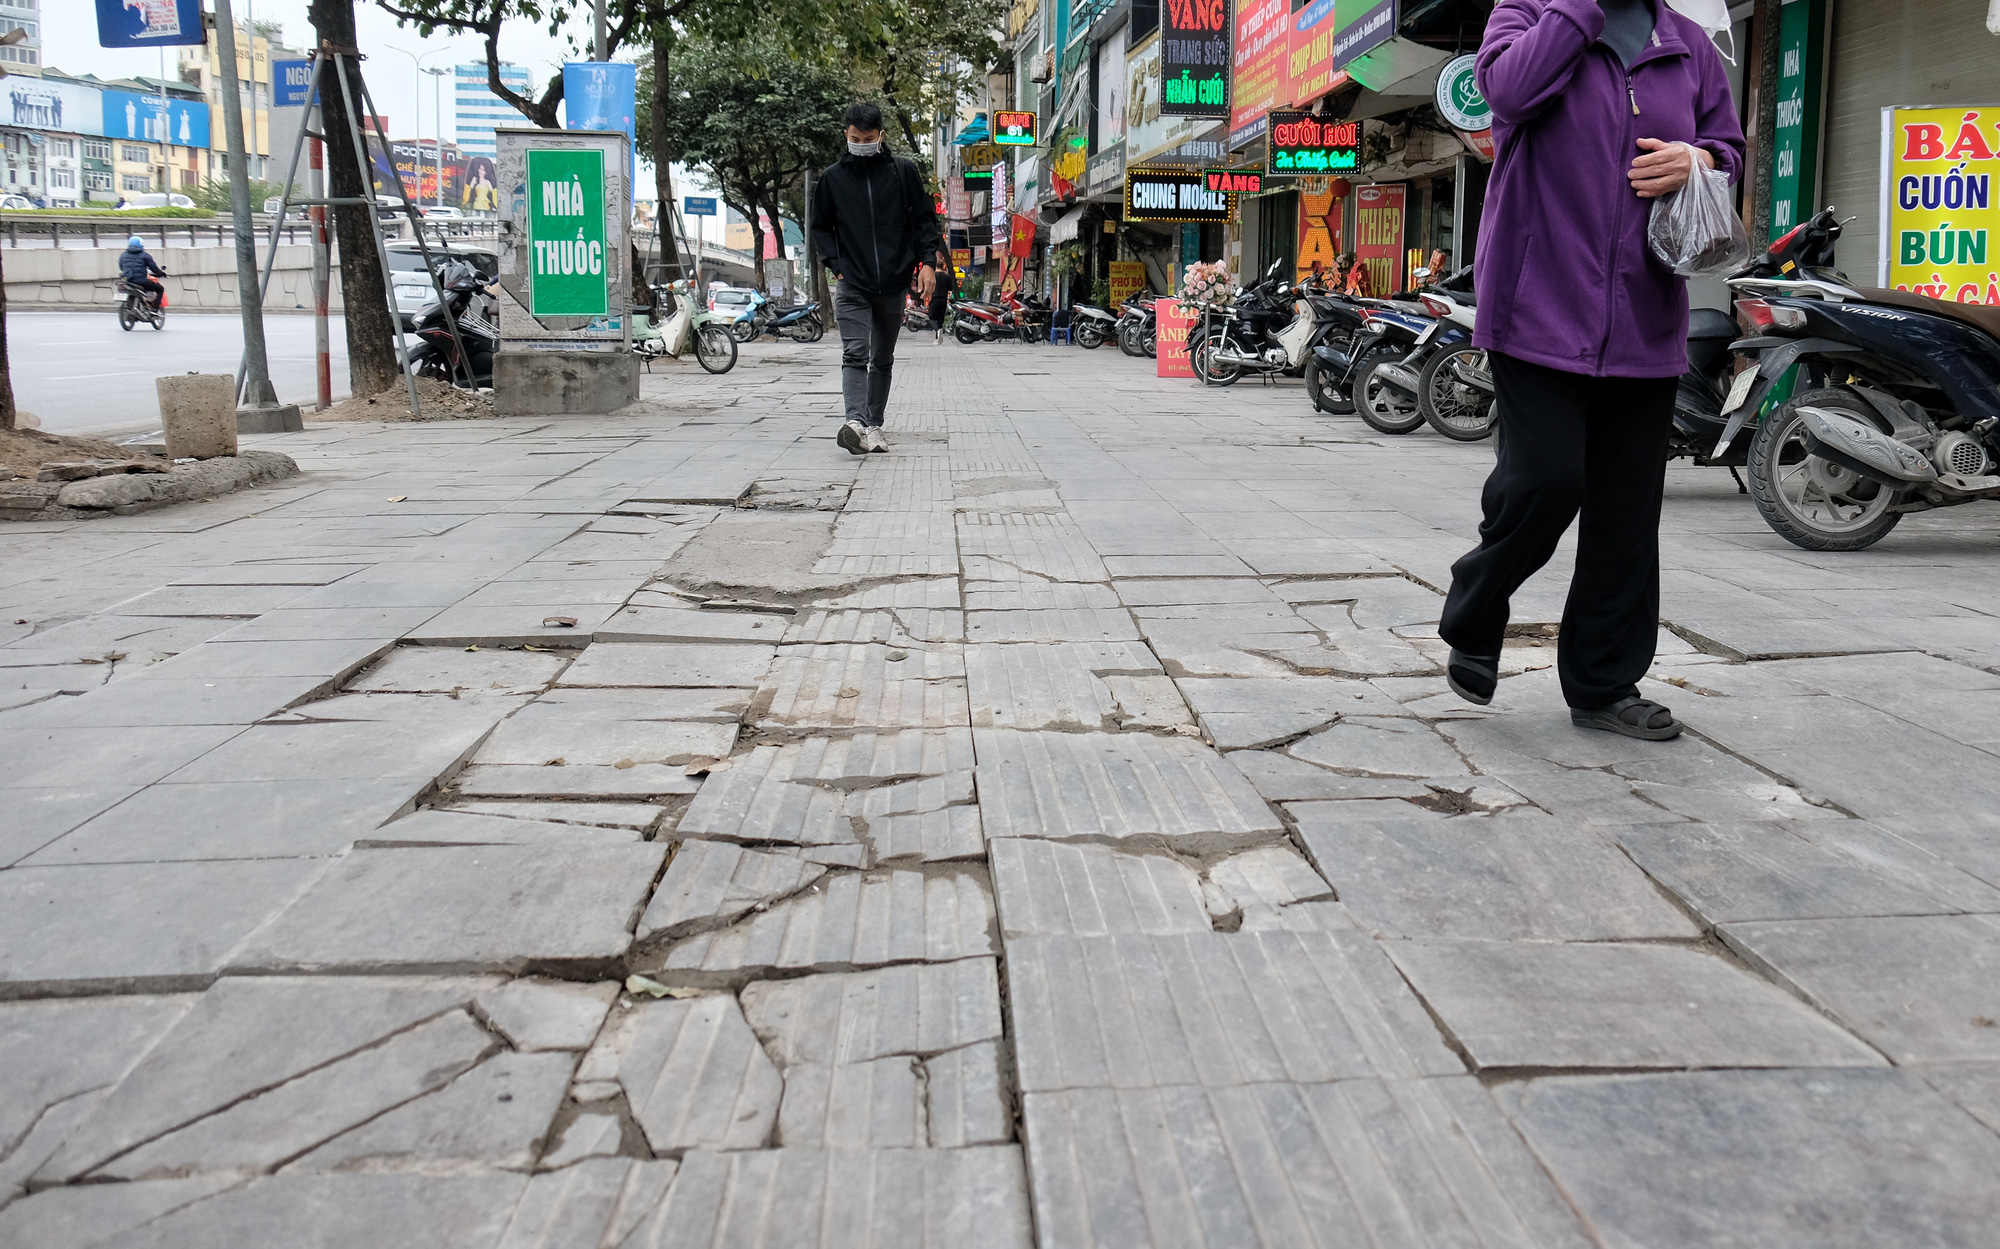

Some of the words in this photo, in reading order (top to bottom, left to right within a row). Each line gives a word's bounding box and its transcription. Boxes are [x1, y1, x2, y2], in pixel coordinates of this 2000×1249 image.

[1280, 13, 1288, 35] HD
[1166, 39, 1202, 65] TRANG
[1204, 35, 1226, 66] SỨC
[1290, 43, 1311, 80] CHỤP
[1311, 27, 1329, 68] ẢNH
[1783, 40, 1800, 78] NHÀ
[1166, 69, 1197, 104] NHẪN
[1198, 72, 1224, 105] CƯỚI
[1298, 78, 1311, 100] LẤY
[1310, 70, 1329, 93] NGAY
[1443, 73, 1452, 92] NONG
[140, 95, 172, 107] COWY
[1776, 86, 1802, 129] THUỐC
[1274, 117, 1321, 147] CƯỚI
[1902, 112, 2000, 161] BÁ
[396, 161, 414, 173] GHẾ
[414, 164, 451, 178] MASSGE
[1778, 140, 1794, 178] CỦA
[542, 173, 584, 216] NHÀ
[1132, 182, 1177, 210] CHUNG
[1179, 183, 1227, 211] MOBILE
[1207, 171, 1261, 192] VÀNG
[1899, 162, 1989, 210] CUỐN
[1359, 195, 1401, 246] THIẾP
[1774, 199, 1791, 235] MỌI
[534, 226, 602, 276] THUỐC
[1900, 223, 1987, 265] BÚN
[1111, 273, 1130, 288] PHỞ
[1131, 274, 1144, 288] BÒ
[1841, 305, 1908, 322] VISION
[1158, 323, 1187, 342] ẢNH
[1167, 346, 1186, 359] LẤY
